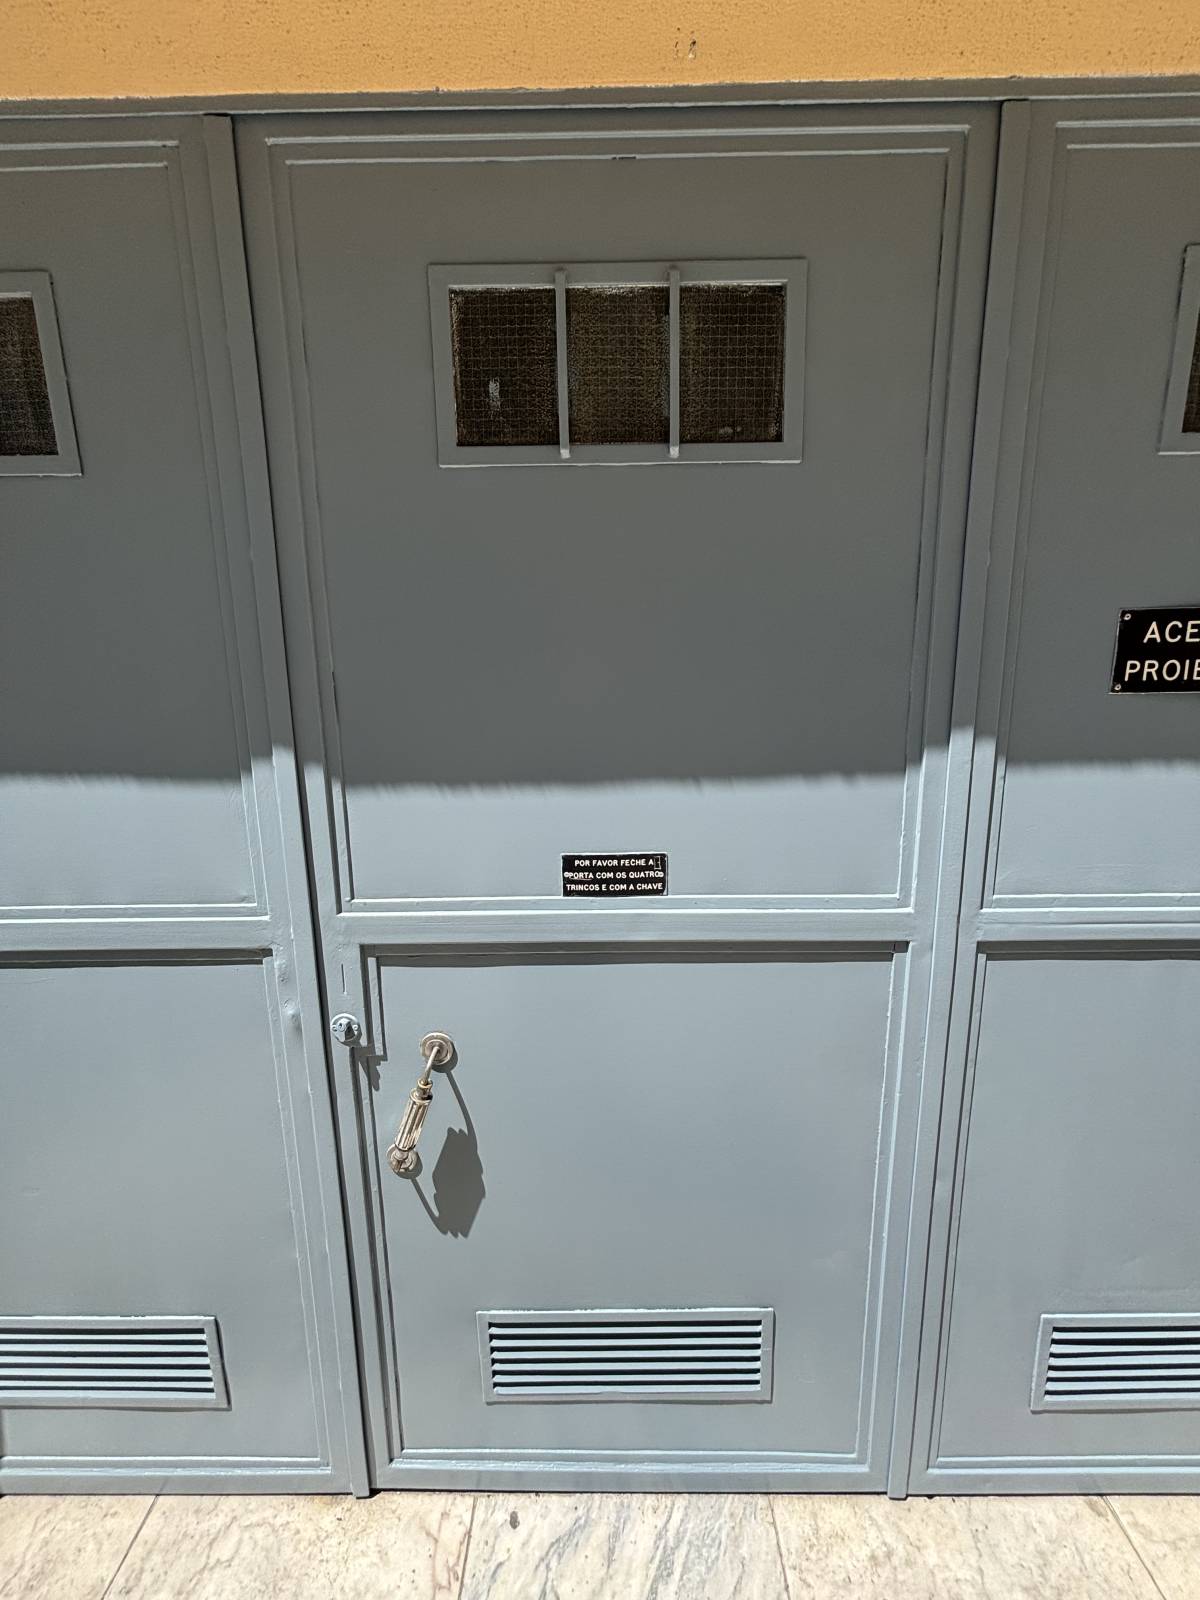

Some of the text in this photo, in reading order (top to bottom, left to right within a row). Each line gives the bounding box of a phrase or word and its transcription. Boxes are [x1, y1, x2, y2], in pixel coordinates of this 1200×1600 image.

[1143, 620, 1200, 643] ACE
[575, 859, 590, 867] POR
[628, 870, 660, 878] QUATRO
